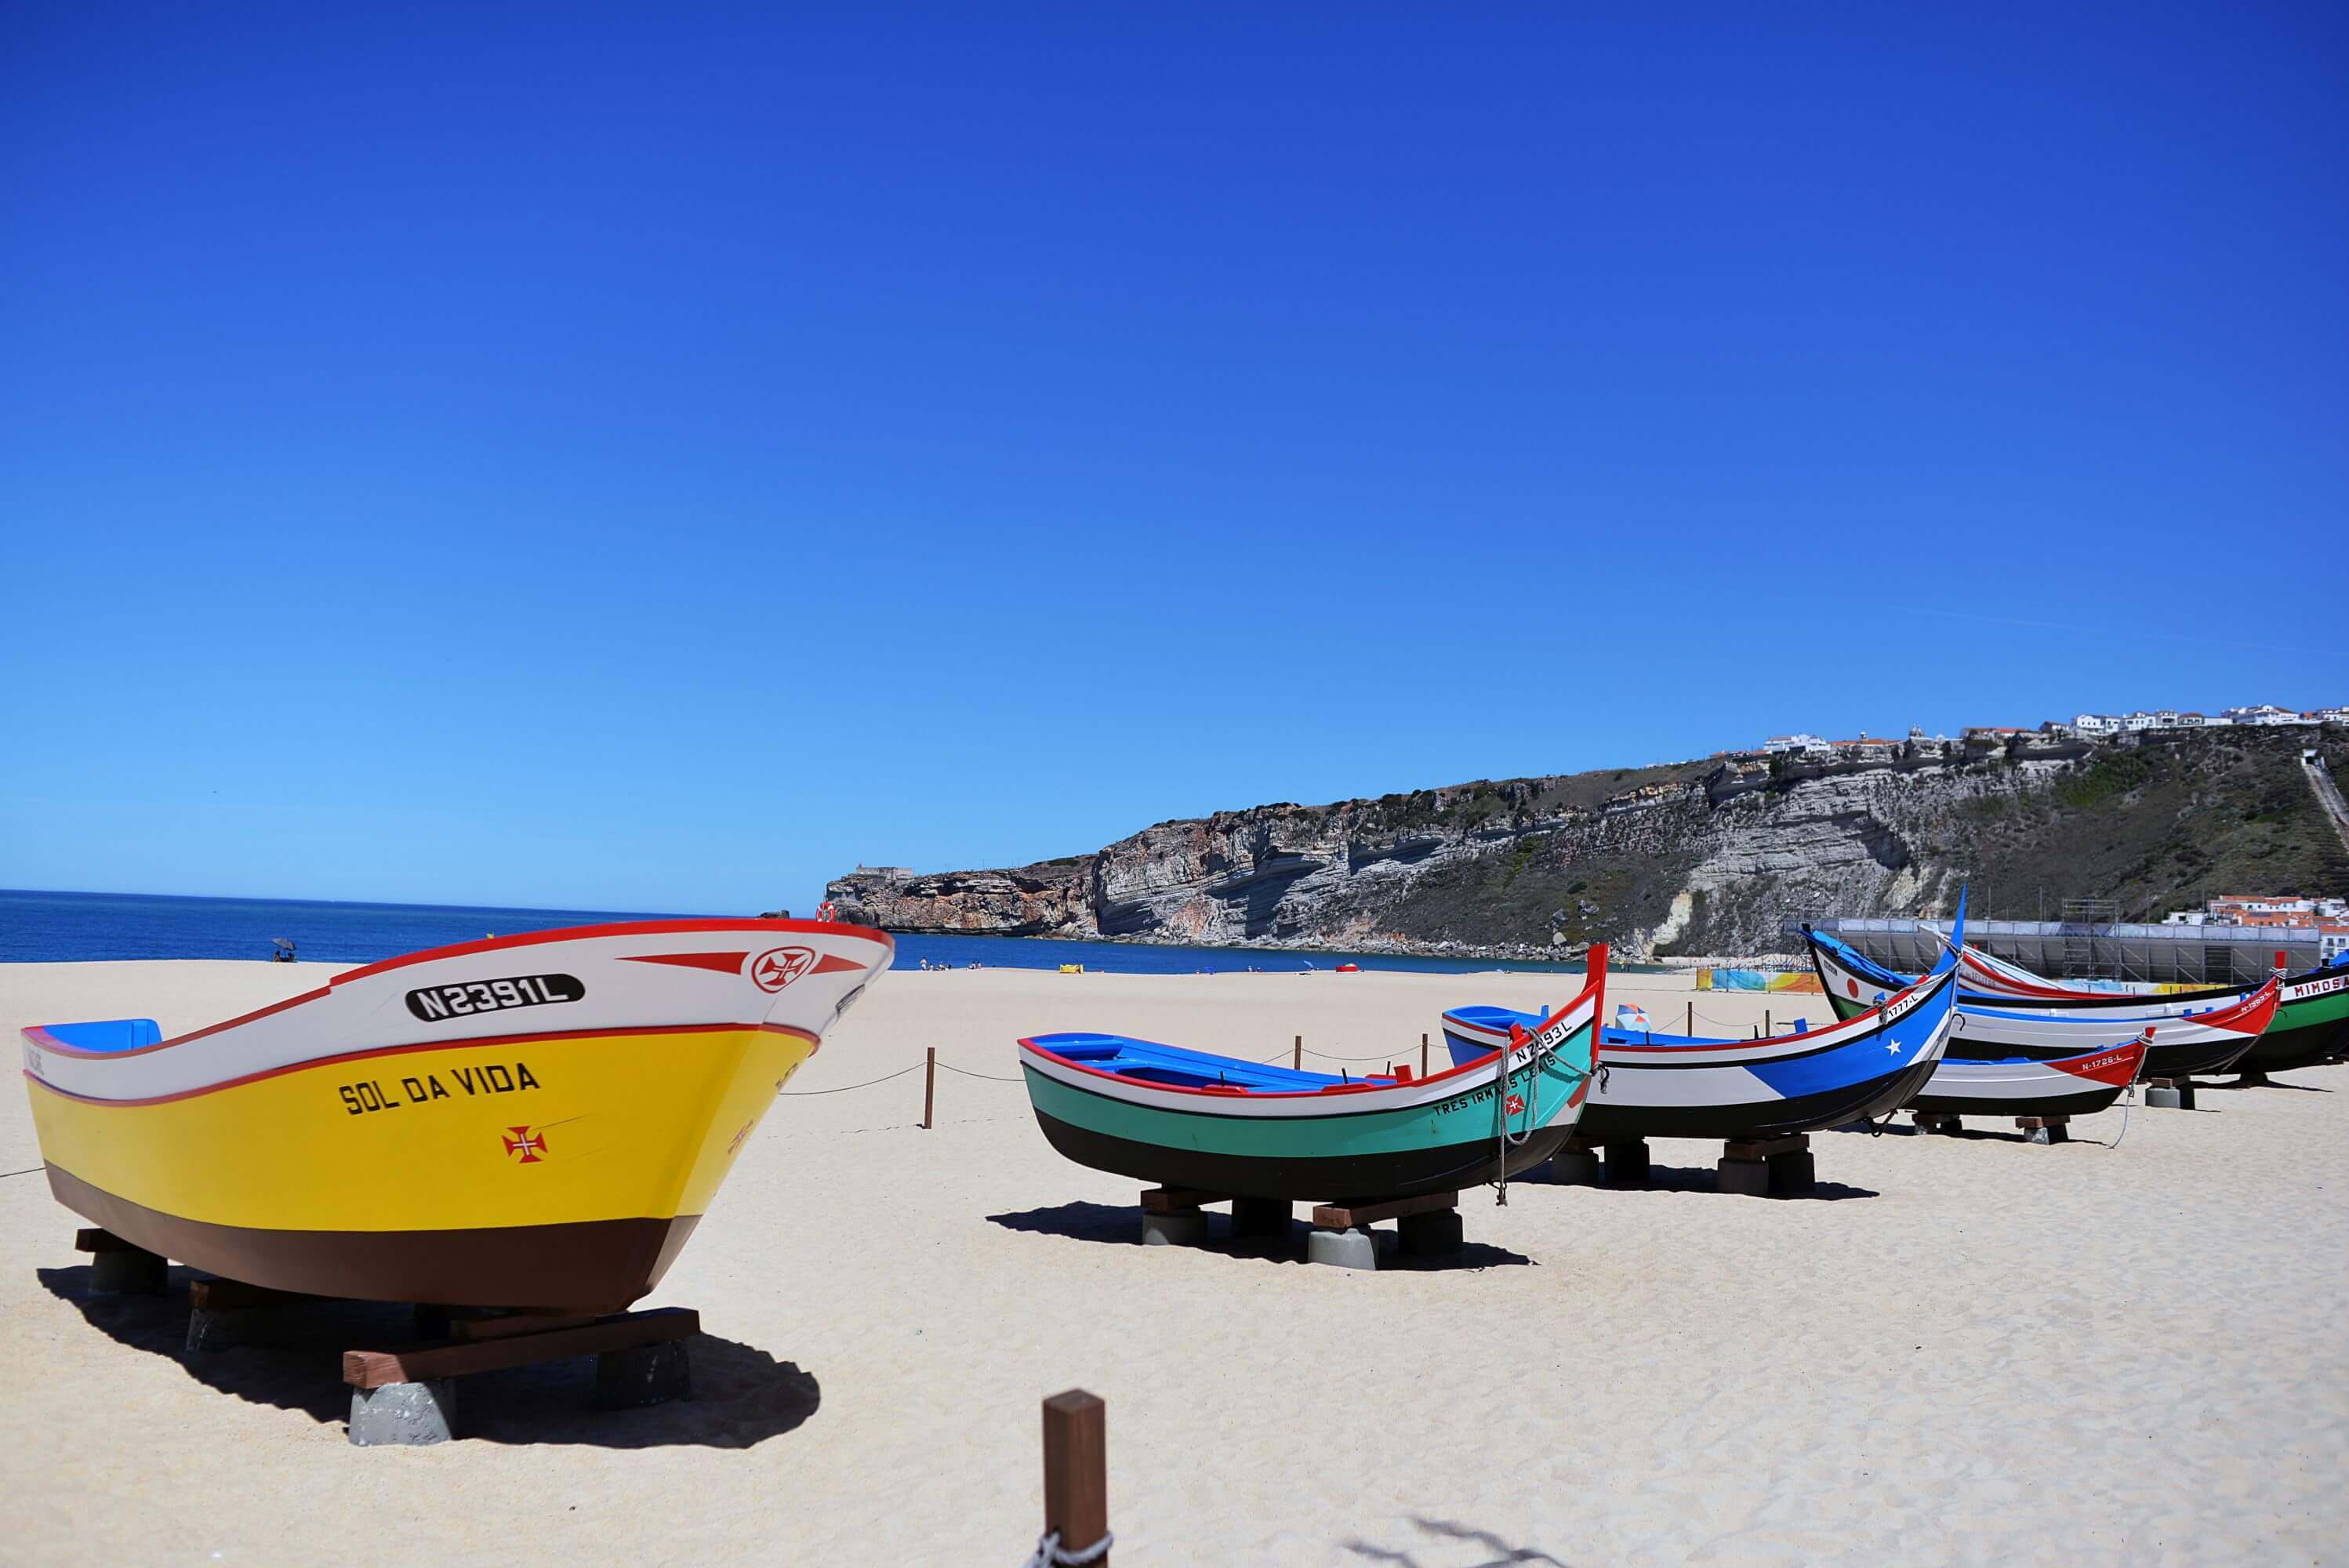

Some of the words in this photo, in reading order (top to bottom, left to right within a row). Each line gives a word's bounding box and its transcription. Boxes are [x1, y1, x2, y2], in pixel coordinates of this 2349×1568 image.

[417, 978, 569, 1018] N2391L
[338, 1080, 401, 1115] SOL
[401, 1075, 450, 1103] DA
[451, 1062, 540, 1095] VIDA
[1432, 1098, 1468, 1116] TRES
